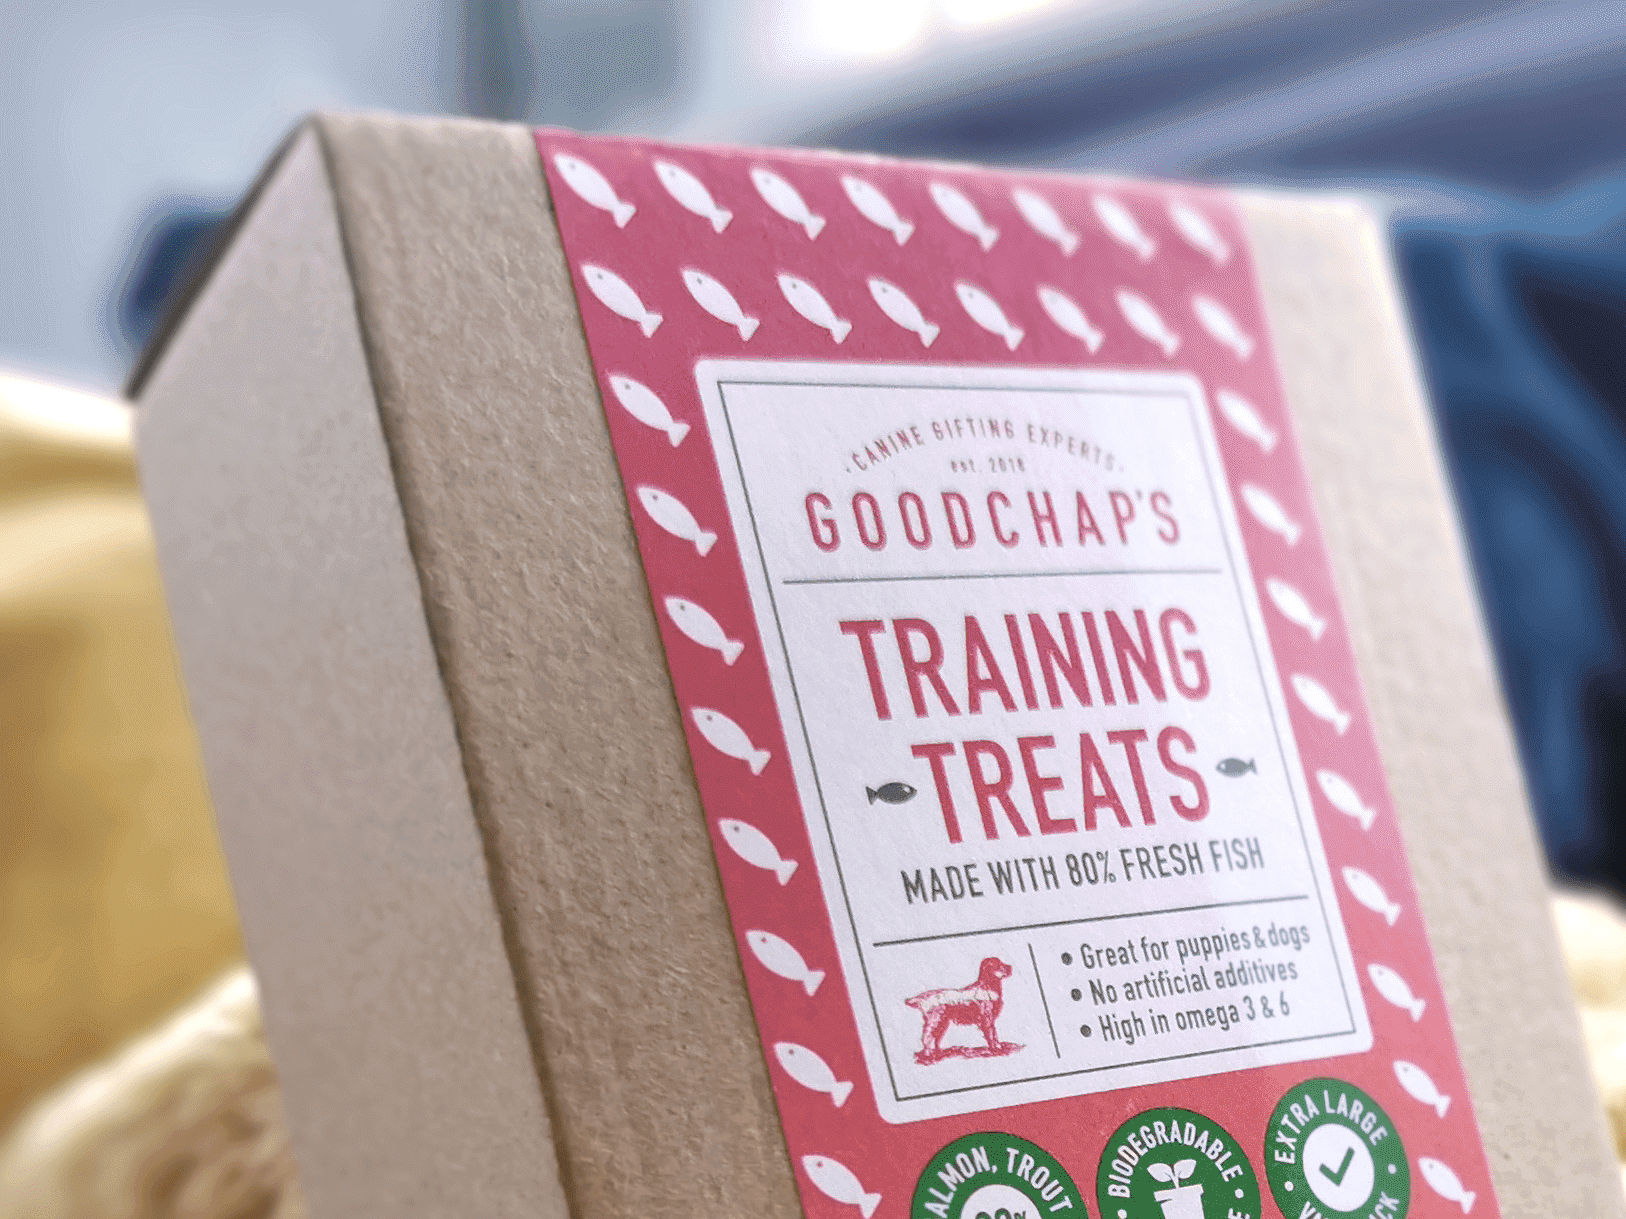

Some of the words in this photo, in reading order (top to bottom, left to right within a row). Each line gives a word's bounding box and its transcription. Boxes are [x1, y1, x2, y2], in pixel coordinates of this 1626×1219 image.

[931, 417, 1015, 441] GIFTING
[804, 490, 1181, 552] GOODCHAP'S
[839, 607, 1211, 721] TRAINING
[910, 725, 1211, 844] TREATS
[900, 863, 984, 904] MADE
[986, 855, 1058, 894] WITH
[1065, 851, 1117, 886] 80%
[1119, 842, 1205, 881] FRESH
[1208, 837, 1266, 872] FISH
[1080, 939, 1139, 969] Great
[1141, 936, 1170, 962] for
[1175, 926, 1251, 965] puppies
[1252, 925, 1266, 948] &
[1267, 921, 1311, 951] dogs
[1088, 977, 1118, 1006] No
[1123, 965, 1210, 1001] artificial
[1213, 959, 1299, 990] additives
[1099, 1011, 1146, 1045] High
[1149, 1008, 1170, 1035] in
[1175, 1003, 1241, 1031] omega
[1243, 995, 1256, 1020] 3
[1261, 995, 1275, 1018] &
[1280, 990, 1291, 1016] 6
[1107, 1119, 1244, 1199] BIODEGRADABLE
[1274, 1093, 1321, 1165] EXTRA
[1323, 1089, 1389, 1147] LARGE
[1006, 1147, 1074, 1213] TROUT
